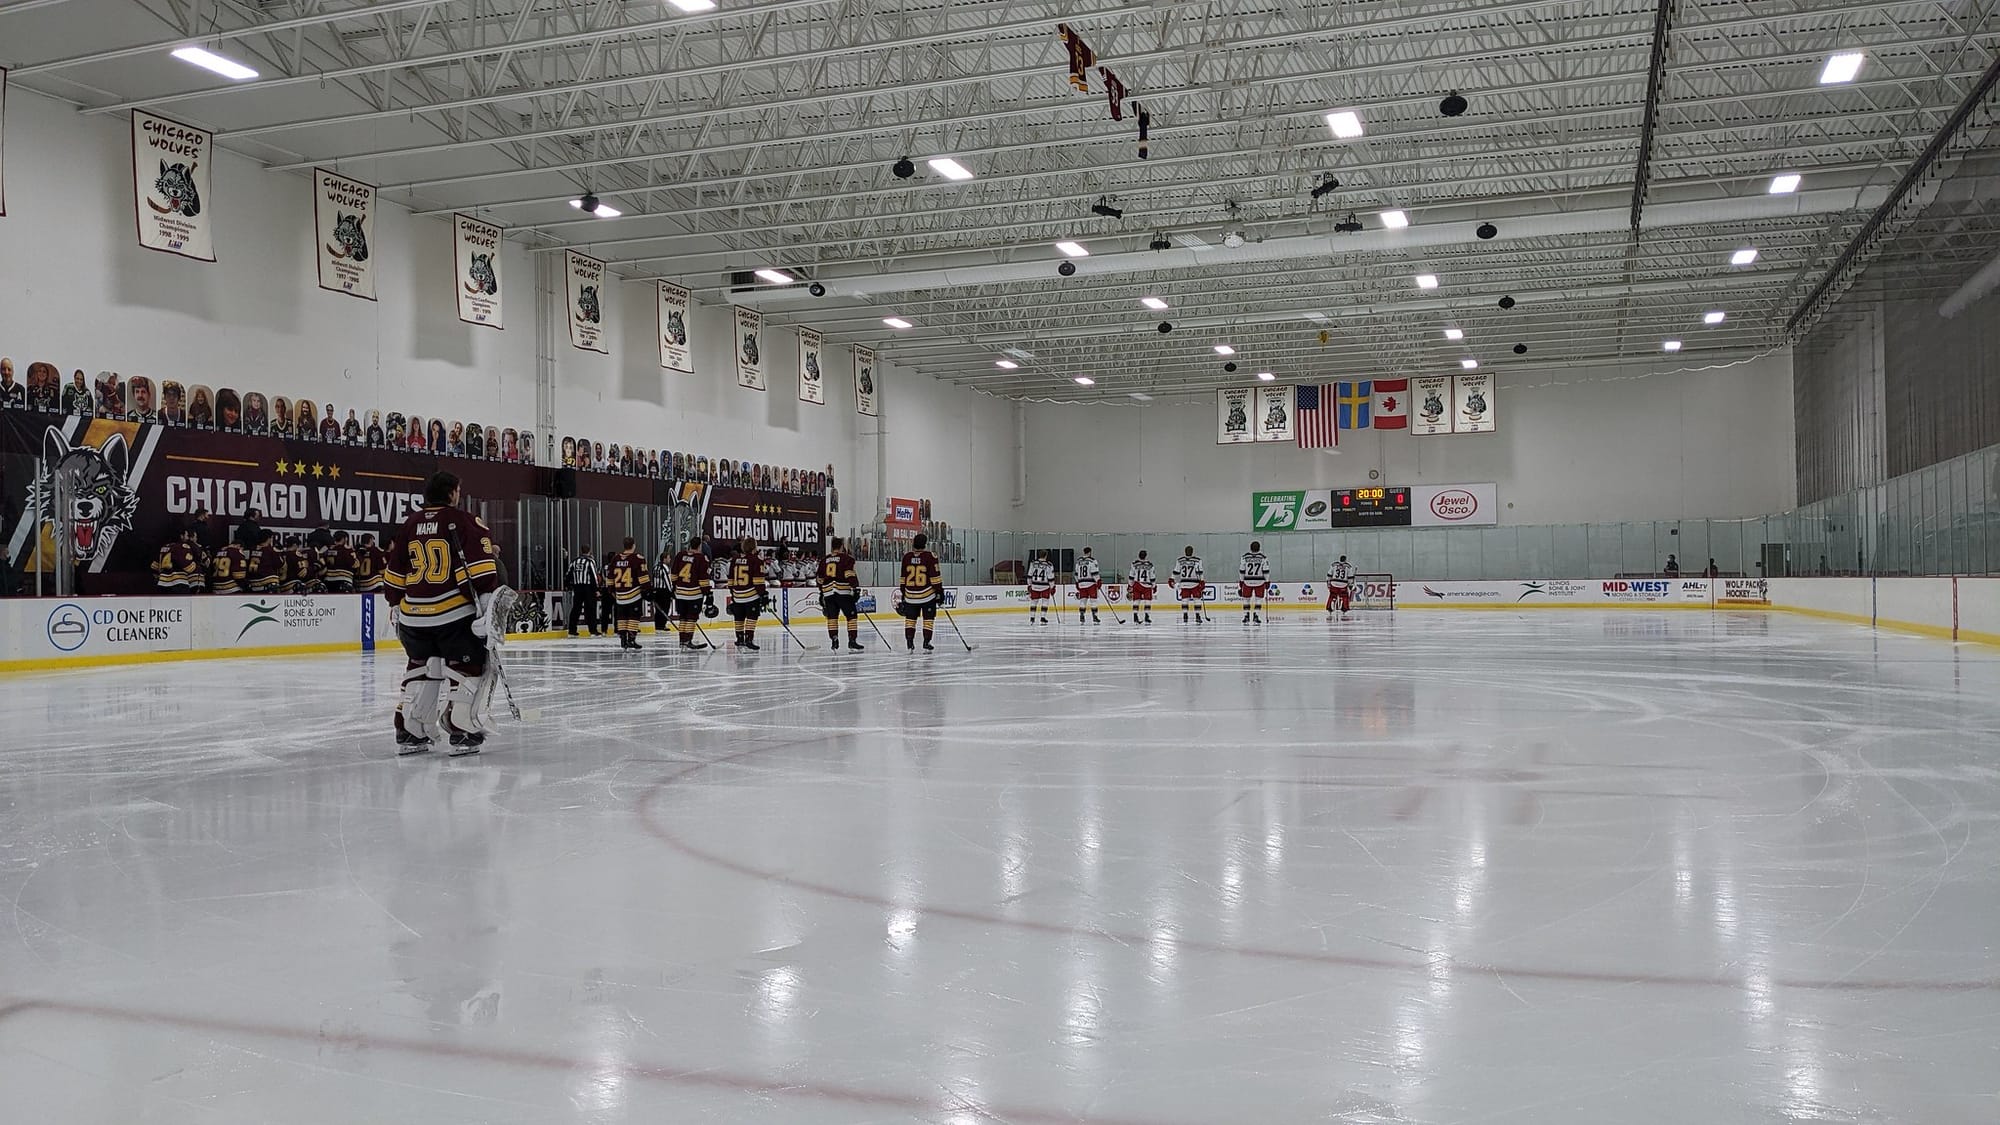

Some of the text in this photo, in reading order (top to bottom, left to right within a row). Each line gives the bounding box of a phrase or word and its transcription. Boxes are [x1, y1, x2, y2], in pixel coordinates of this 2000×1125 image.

[142, 120, 204, 145] CHICAGO
[148, 136, 199, 159] WOLVES
[322, 177, 370, 199] CHICAGO
[327, 191, 366, 212] WOLVES
[159, 222, 190, 234] Champions
[460, 220, 498, 239] CHICAGO
[464, 232, 496, 250] WOLVES
[570, 256, 602, 272] CHICAGO
[573, 266, 600, 282] WOLVES
[661, 284, 688, 299] CHICAGO
[664, 294, 686, 308] WOLVES
[737, 310, 760, 322] CHICAGO
[740, 319, 758, 331] WOLVES
[166, 476, 424, 524] CHICAGO WOLVES
[1358, 488, 1383, 498] 20:00
[1397, 494, 1404, 504] 0
[1344, 496, 1350, 506] 0
[1436, 496, 1470, 506] Jewel
[1256, 502, 1296, 528] 75
[1438, 506, 1468, 514] Osco
[713, 515, 818, 543] CHICAGO WOLVES
[406, 538, 450, 585] 30
[678, 563, 692, 582] 4
[734, 565, 750, 586] 15
[826, 562, 836, 577] 9
[906, 565, 927, 586] 26
[1032, 568, 1046, 580] 44
[1080, 566, 1088, 578] 18
[1137, 570, 1148, 582] 14
[1182, 566, 1195, 578] 37
[1247, 563, 1260, 576] 27
[1335, 569, 1346, 580] 33
[614, 568, 632, 588] 24
[1725, 580, 1760, 588] WOLF PACK
[1602, 582, 1670, 592] MID-WEST
[1726, 590, 1750, 598] HOCKEY
[284, 598, 314, 608] ILLINOIS
[93, 609, 182, 624] CD ONE PRICE
[284, 608, 336, 618] BONE & JOINT
[284, 618, 320, 628] INSTITUTE
[106, 627, 168, 642] CLEANERS
